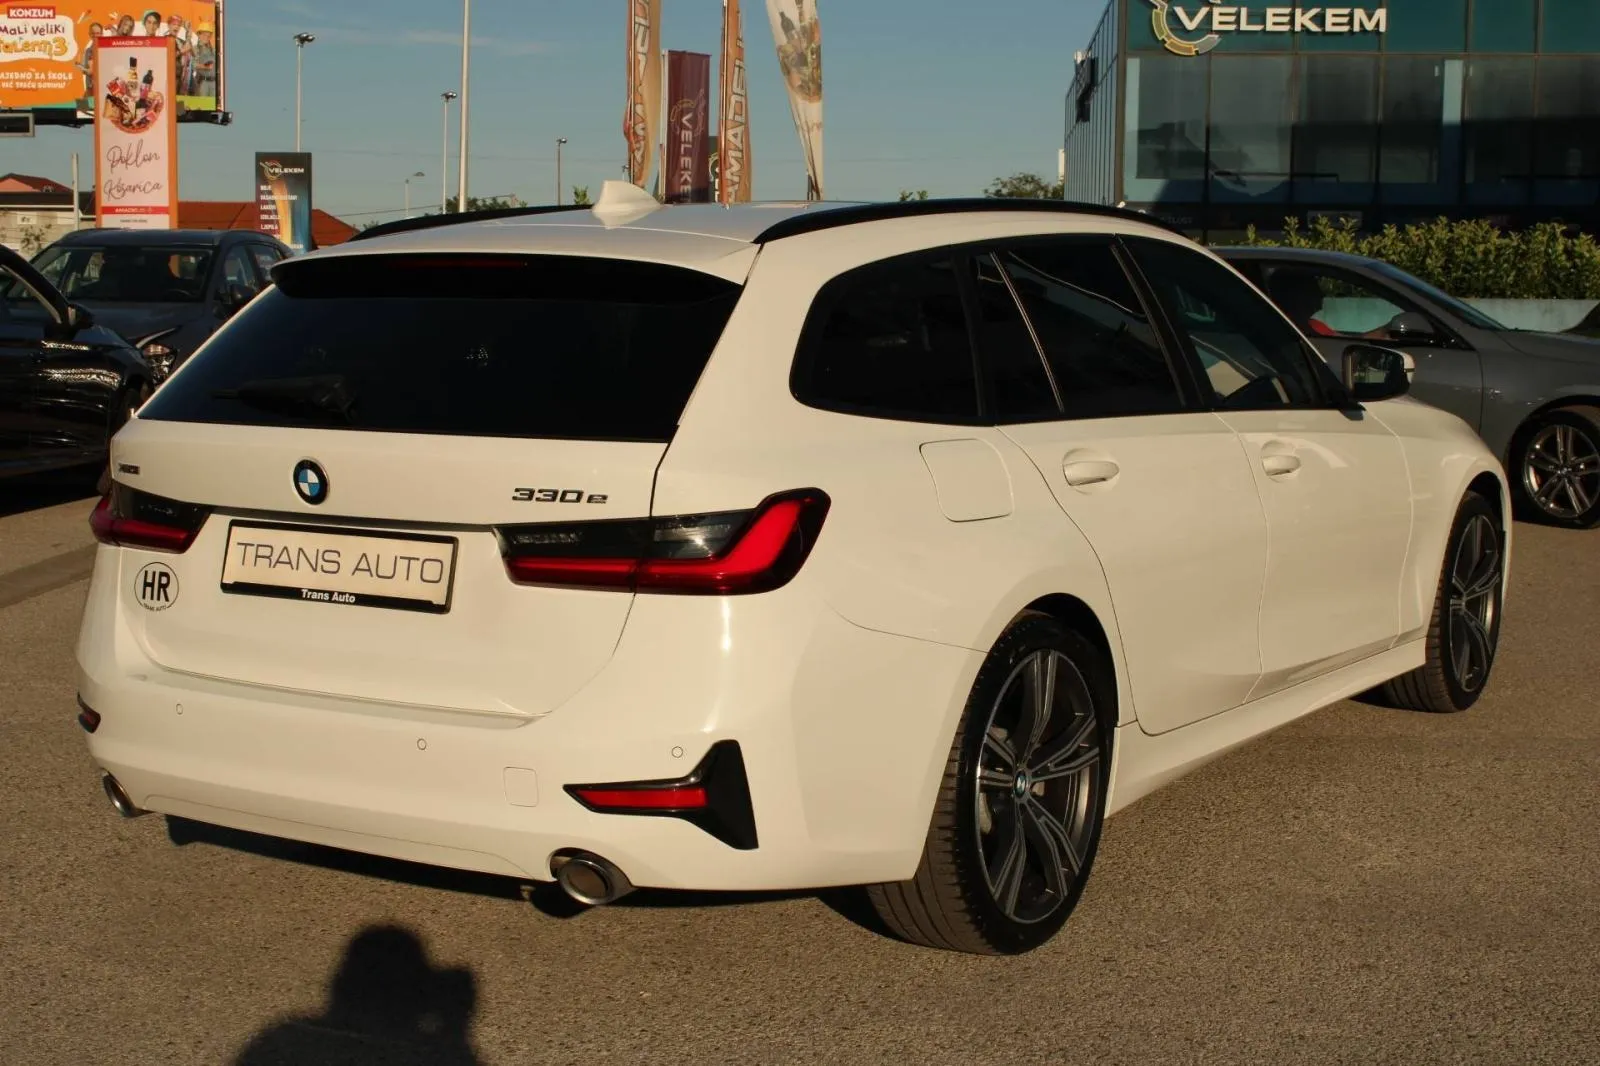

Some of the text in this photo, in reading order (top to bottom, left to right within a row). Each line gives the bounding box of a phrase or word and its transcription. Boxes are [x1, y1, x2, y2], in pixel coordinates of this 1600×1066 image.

[9, 8, 54, 18] KONZUM
[1173, 6, 1388, 33] VELEKEM
[0, 72, 33, 80] AJEDNO
[237, 542, 444, 584] TRANS AUTO
[142, 570, 170, 602] HR
[301, 588, 356, 604] Trans Auto
